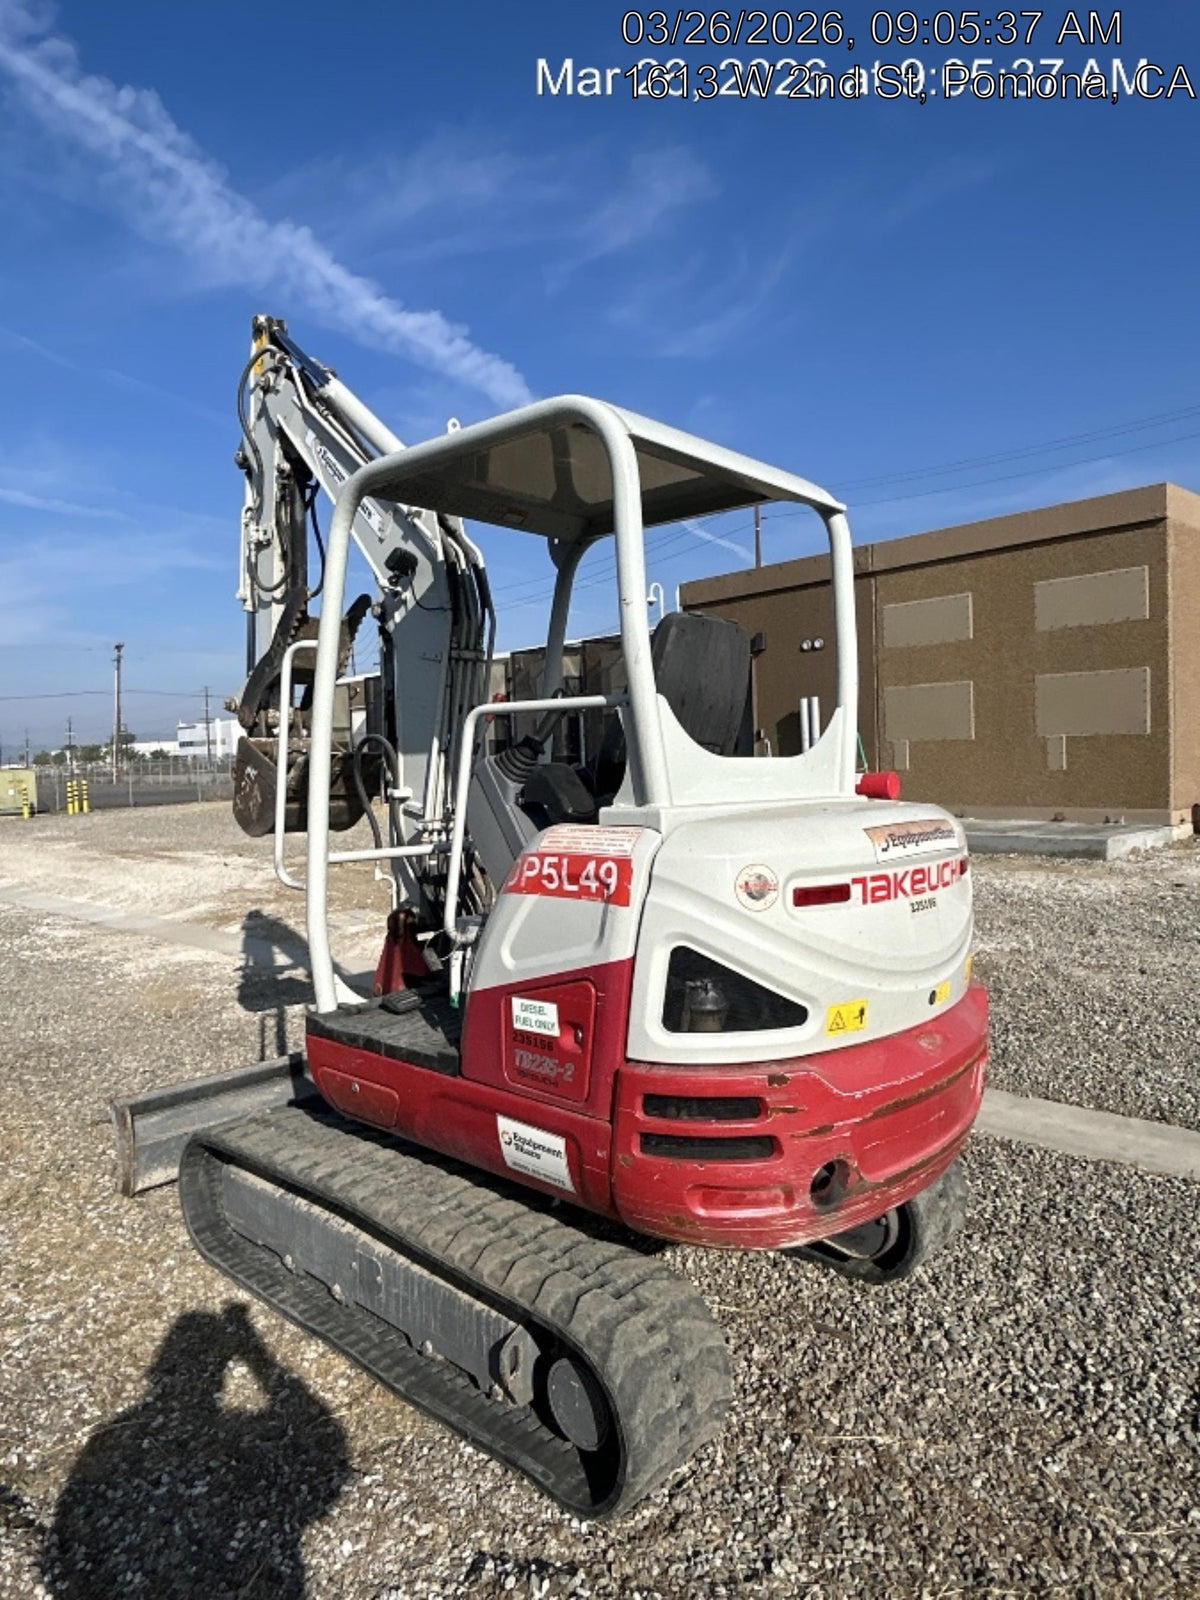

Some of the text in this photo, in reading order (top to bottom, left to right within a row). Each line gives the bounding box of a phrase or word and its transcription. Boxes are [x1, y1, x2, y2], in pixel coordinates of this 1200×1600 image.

[851, 856, 962, 905] TAKEUCH
[520, 1002, 548, 1016] DIESEL
[515, 1014, 534, 1029] FUEL
